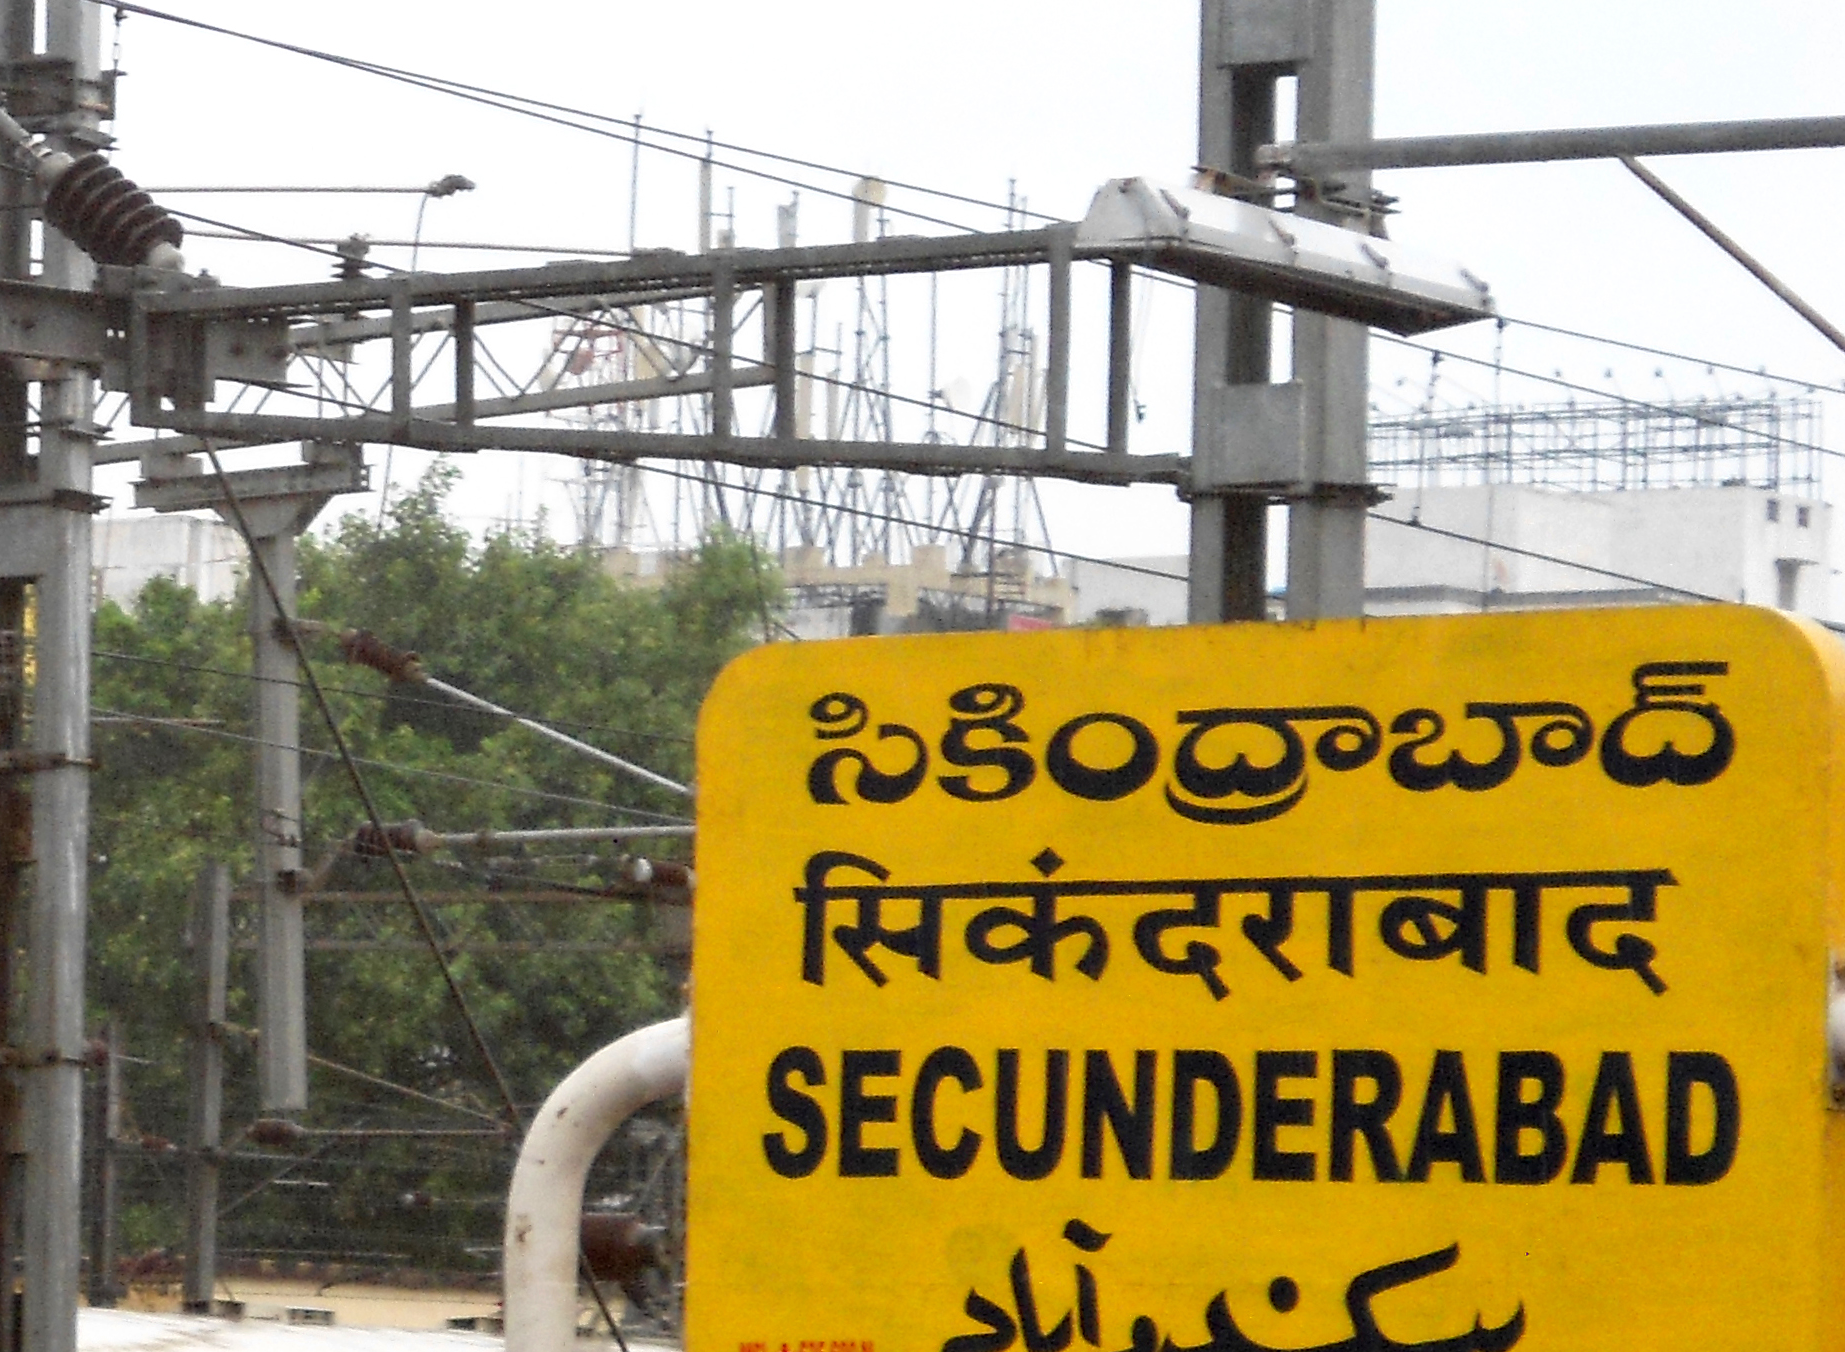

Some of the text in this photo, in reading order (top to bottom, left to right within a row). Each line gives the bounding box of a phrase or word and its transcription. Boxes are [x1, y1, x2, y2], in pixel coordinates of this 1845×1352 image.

[806, 660, 1735, 826] సికింద్రాబాద్
[792, 847, 1679, 1002] सिकंदराबाद
[762, 1045, 1741, 1187] SECUNDERABAD
